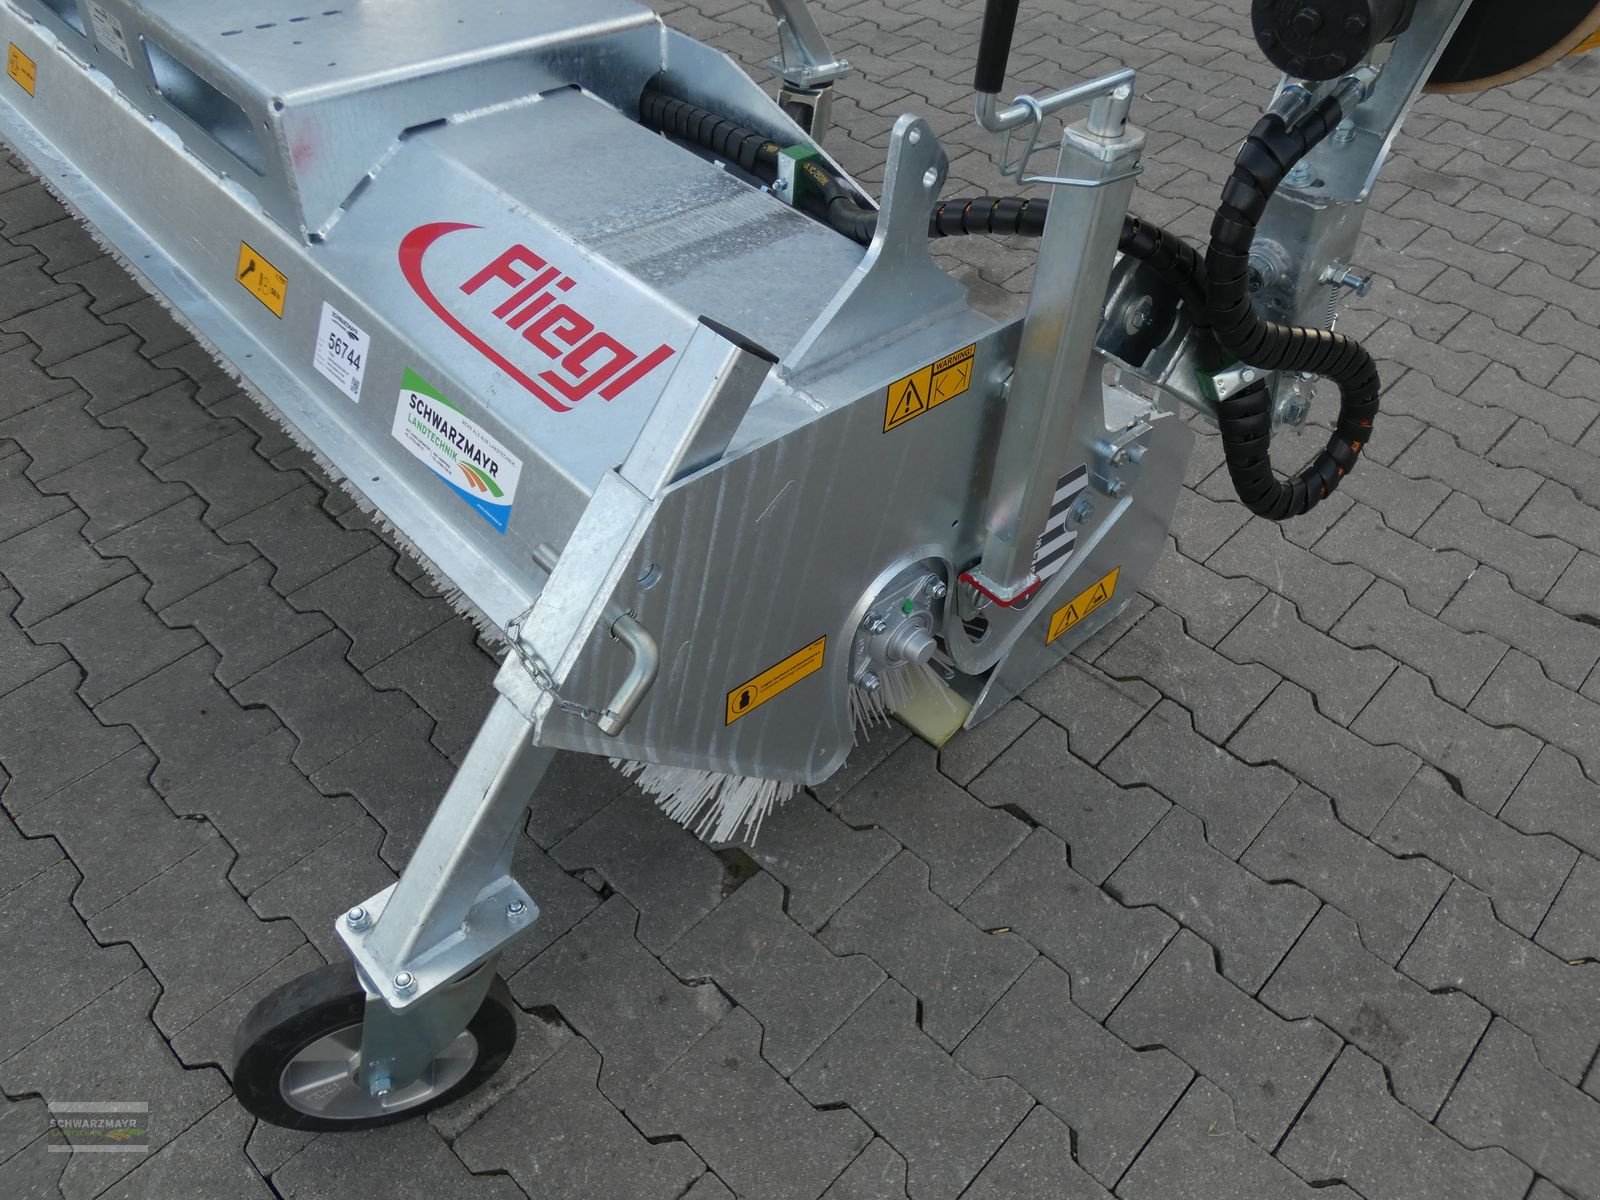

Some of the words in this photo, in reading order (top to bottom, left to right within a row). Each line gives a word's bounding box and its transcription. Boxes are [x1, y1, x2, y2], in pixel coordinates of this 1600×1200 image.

[459, 243, 676, 402] Fliegl
[328, 332, 361, 371] 56744
[936, 347, 973, 370] WARNING!
[407, 412, 458, 462] LANDTECHNIK
[409, 393, 498, 478] SCHWARZMAYR
